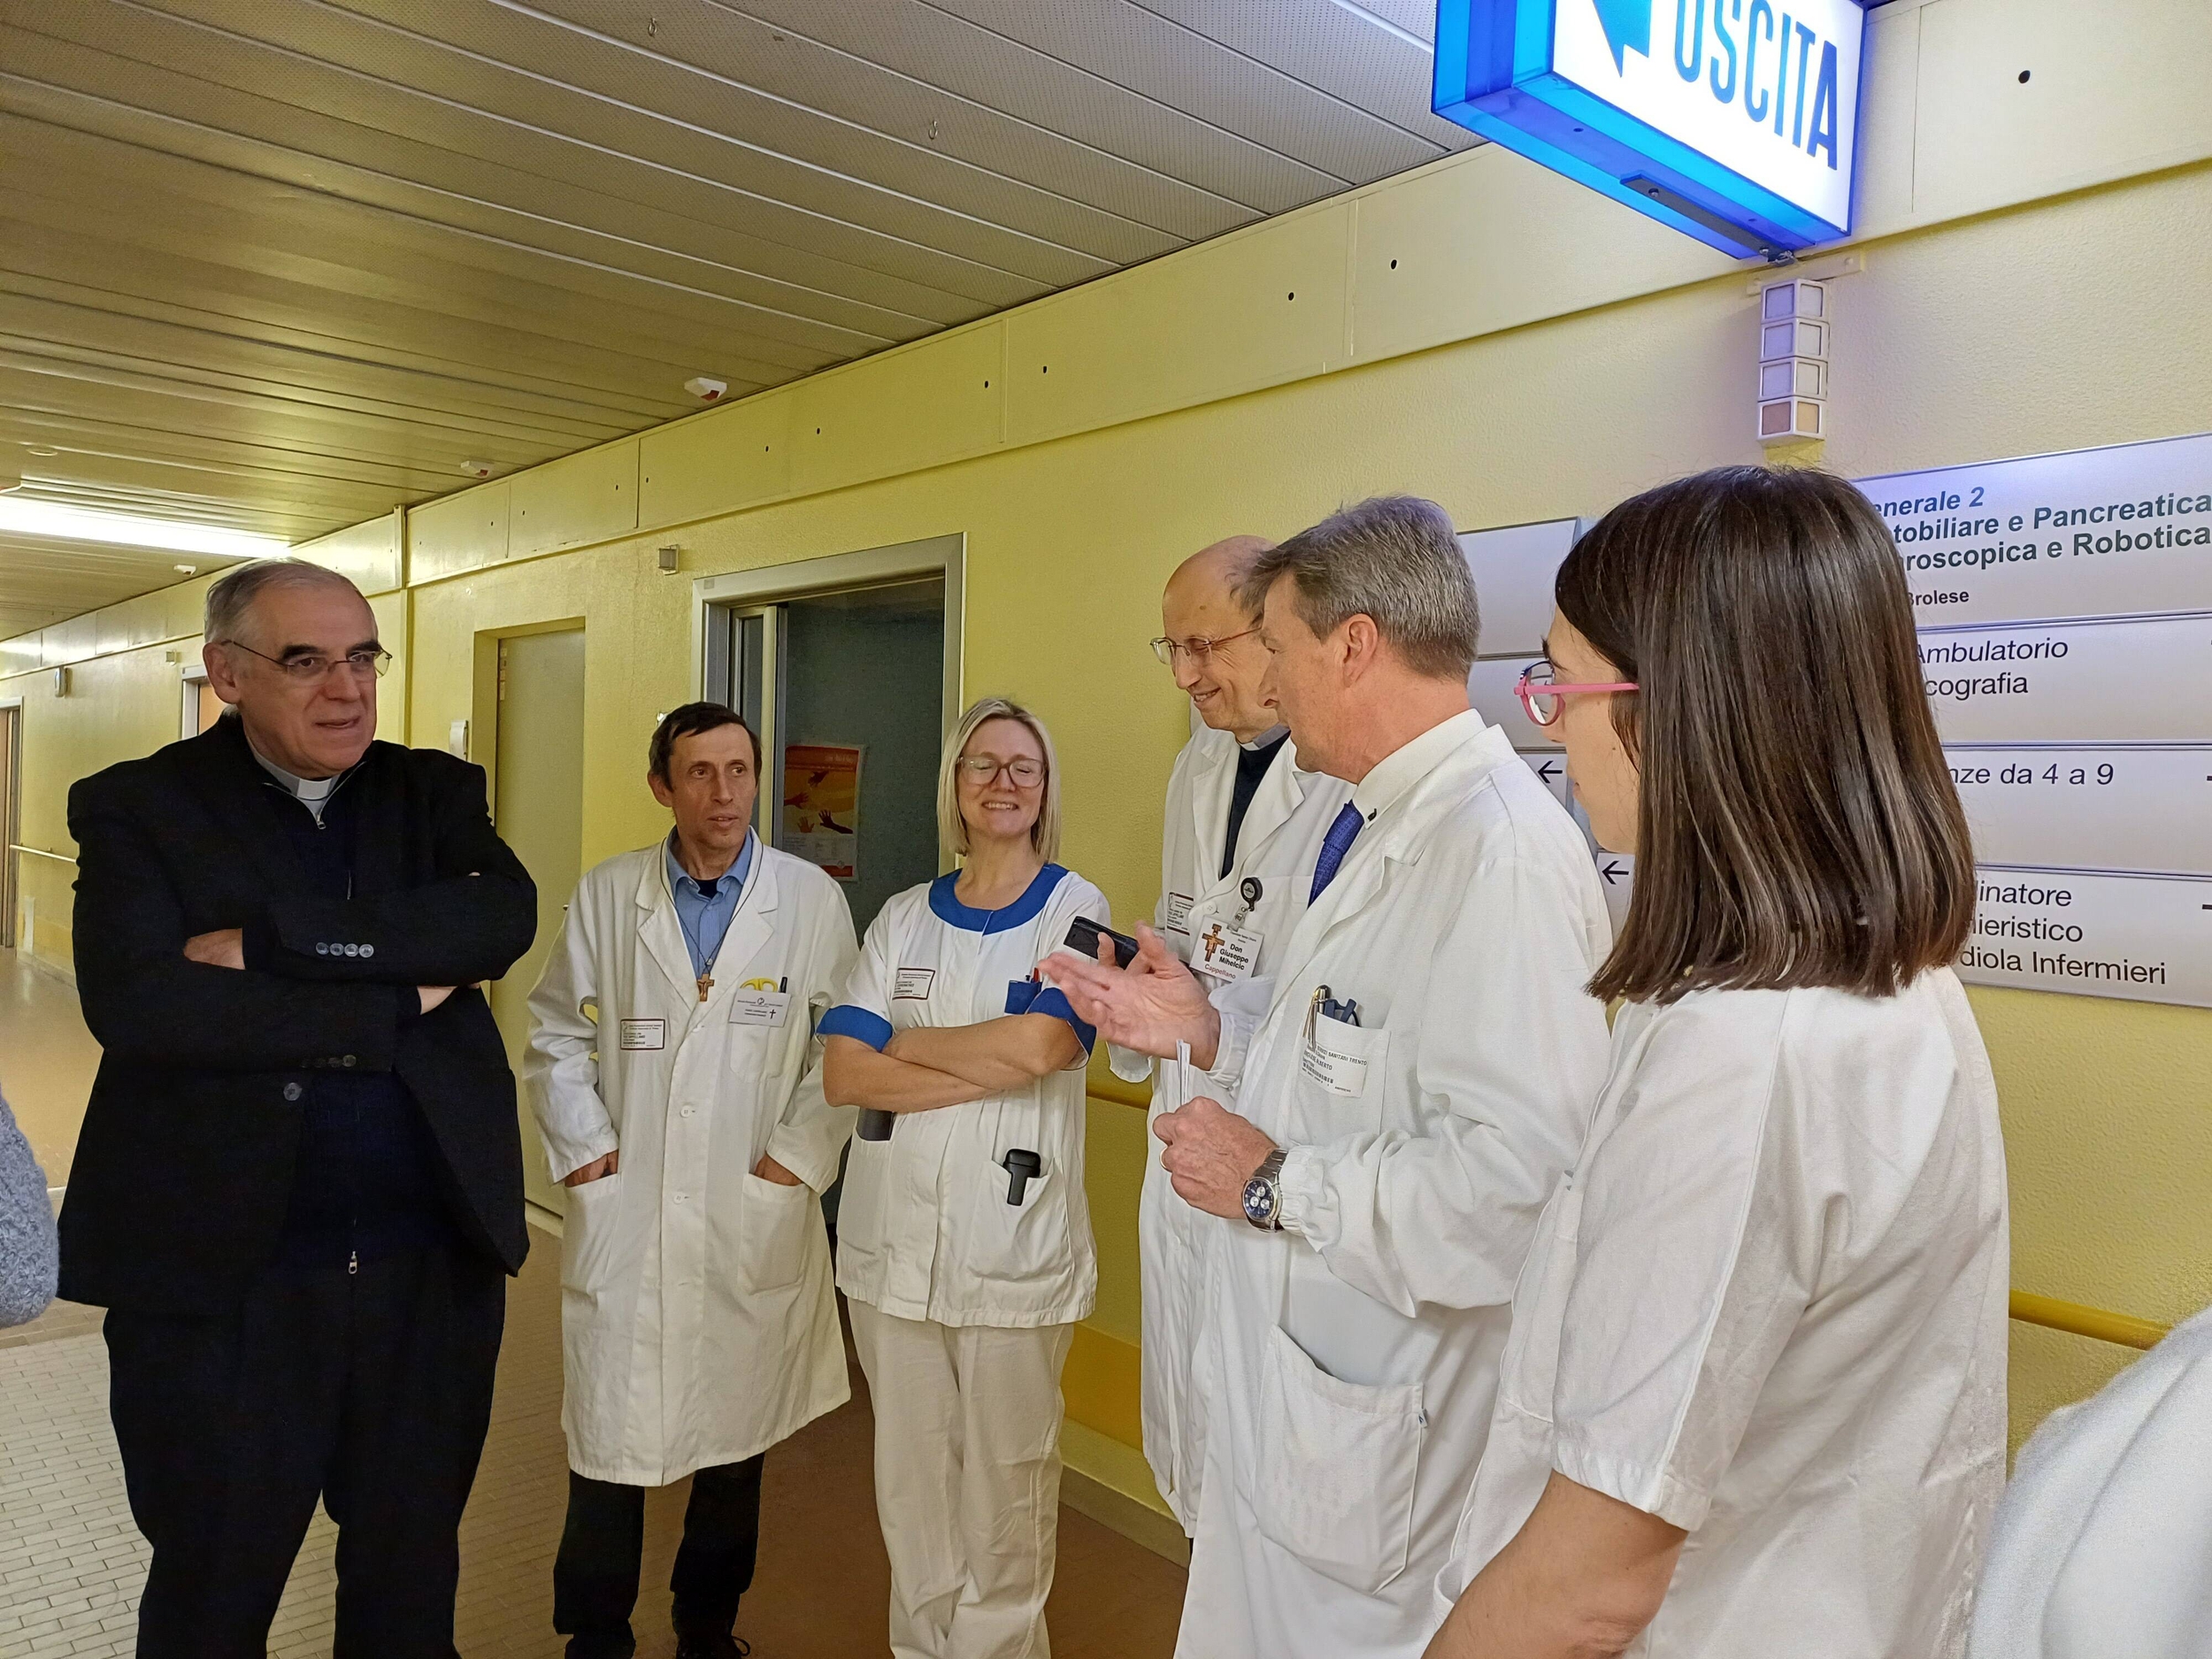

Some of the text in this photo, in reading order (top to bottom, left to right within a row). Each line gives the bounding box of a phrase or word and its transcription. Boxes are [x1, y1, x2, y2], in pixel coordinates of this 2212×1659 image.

[1674, 0, 1838, 171] USCITA
[1969, 487, 1985, 508] 2
[1893, 493, 2212, 543] tobiliare e Pancreatica
[1907, 525, 2211, 571] roscopica e Robotica
[1924, 672, 2028, 701] cografia
[2000, 764, 2032, 784] da
[2042, 764, 2058, 785] 4
[2069, 768, 2085, 785] a
[2096, 764, 2114, 785] 9
[1976, 879, 2072, 907] inatore
[1230, 943, 1242, 953] Don
[1204, 964, 1236, 979] Cappellano
[1960, 946, 2165, 985] diola Infermieri
